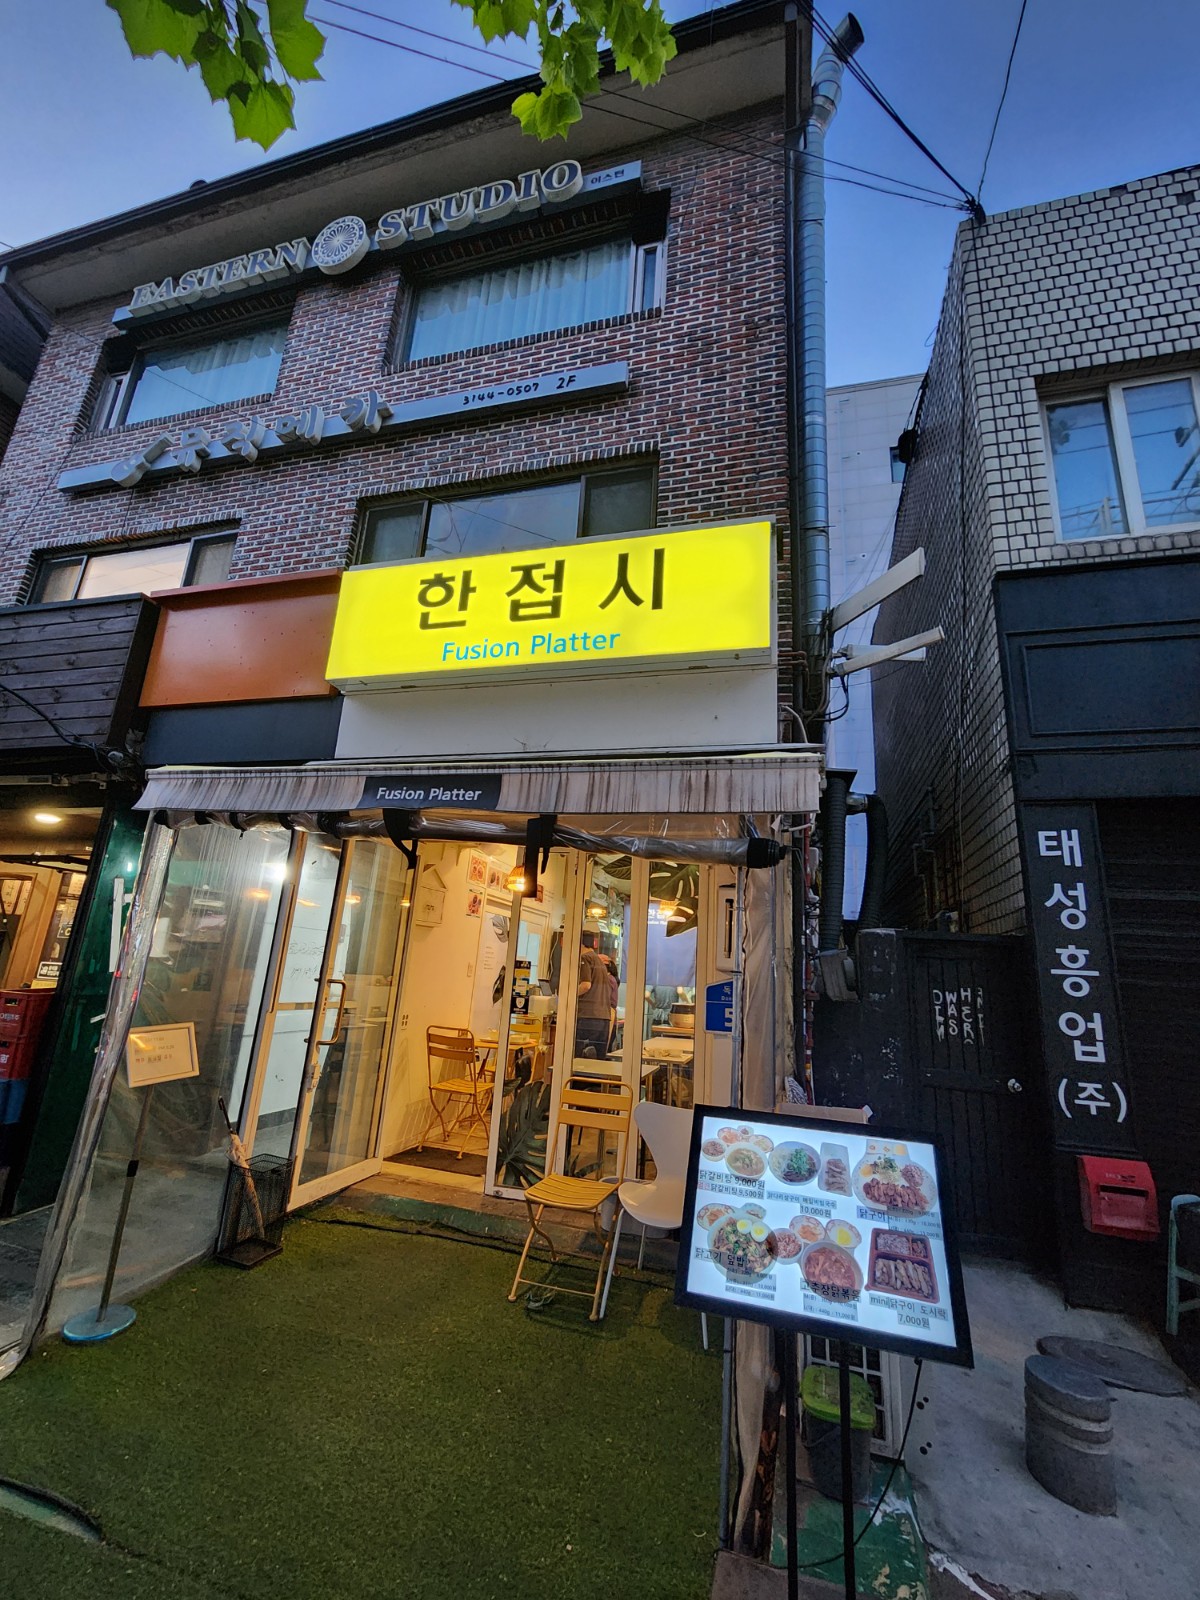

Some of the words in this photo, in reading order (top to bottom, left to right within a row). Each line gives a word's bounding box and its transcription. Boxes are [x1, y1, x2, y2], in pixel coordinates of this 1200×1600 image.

[130, 240, 309, 309] EASTERN
[377, 160, 582, 243] STUDIO
[463, 382, 540, 405] 3144-0507
[556, 375, 577, 389] 2F
[416, 547, 666, 631] 한접시
[441, 638, 520, 662] Fusion
[530, 630, 621, 654] Platter
[376, 786, 426, 801] Fusion
[428, 786, 482, 802] Platter
[1037, 828, 1128, 1123] 태성흥업(주)
[699, 1170, 732, 1184] 닭갈비탕
[734, 1176, 765, 1190] 9,000원
[800, 1205, 832, 1218] 10,000원
[859, 1208, 886, 1222] 닭구이
[695, 1247, 722, 1263] 닭고기
[727, 1253, 745, 1267] 덮밥
[801, 1280, 861, 1302] 고추장닭볶음
[897, 1313, 930, 1328] 7,000원
[920, 1305, 947, 1319] 도시락
